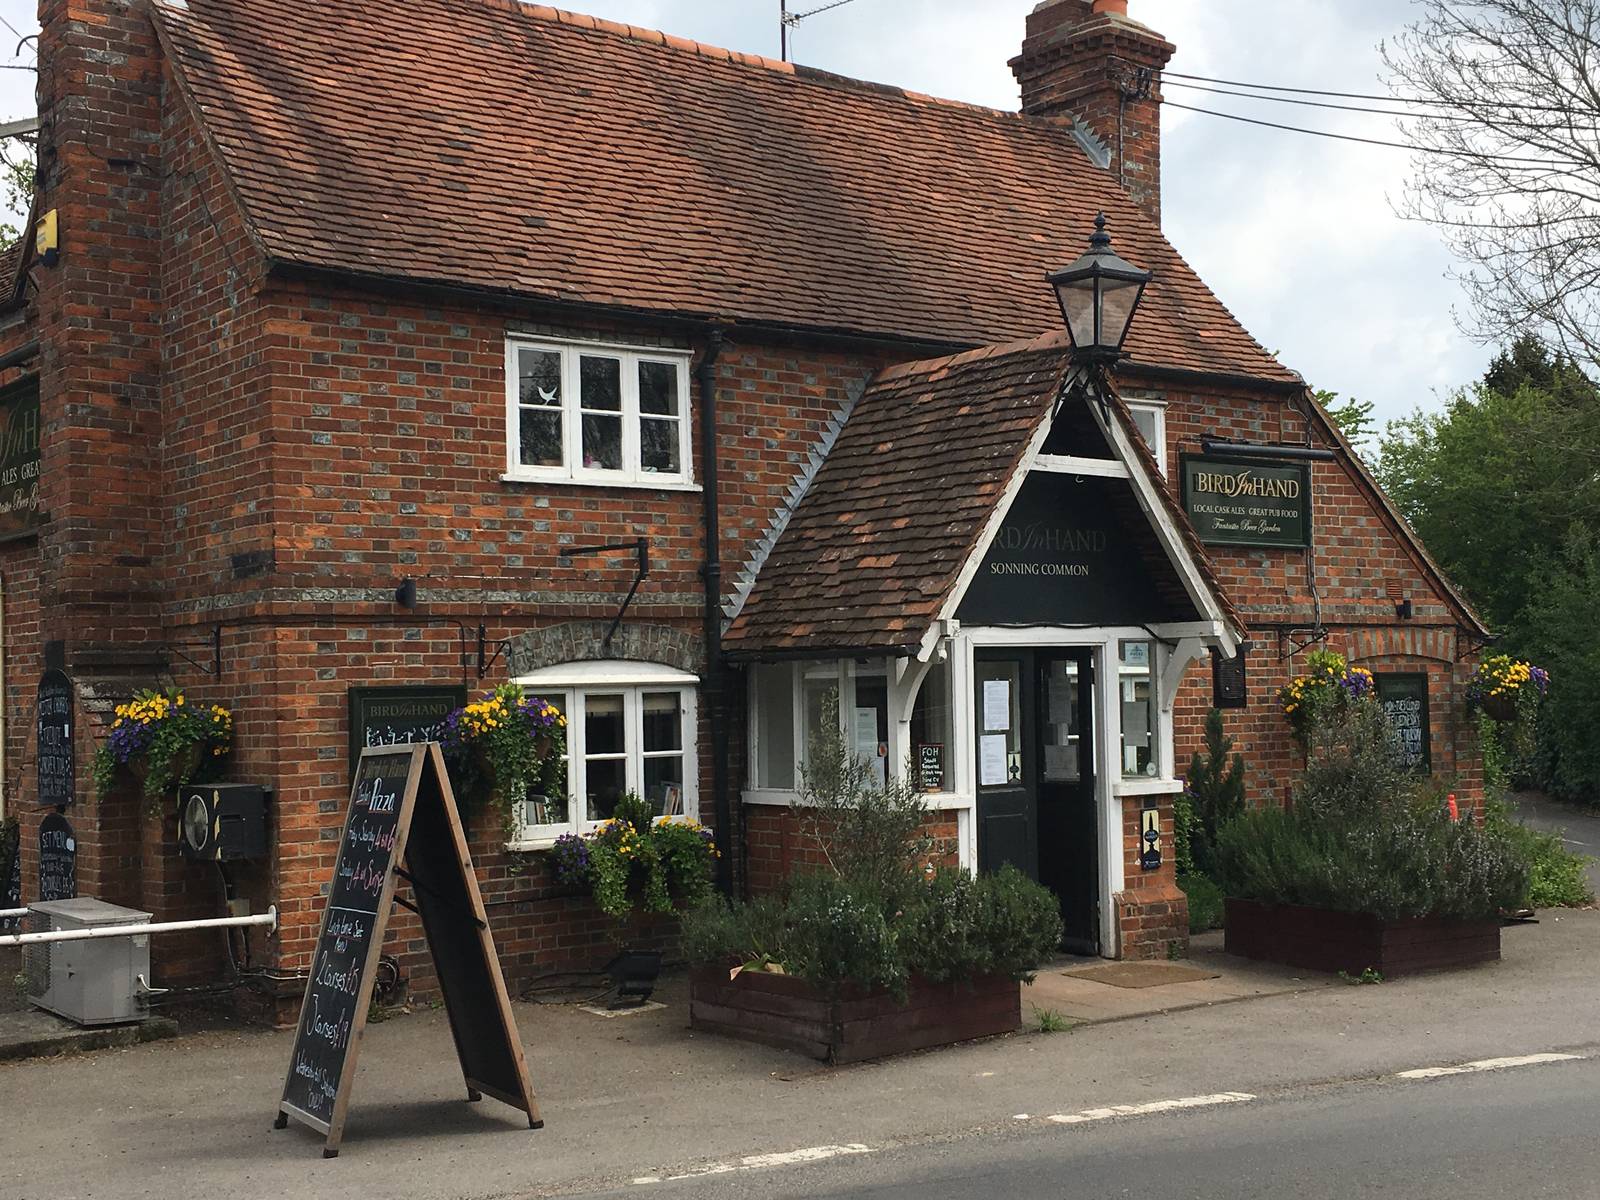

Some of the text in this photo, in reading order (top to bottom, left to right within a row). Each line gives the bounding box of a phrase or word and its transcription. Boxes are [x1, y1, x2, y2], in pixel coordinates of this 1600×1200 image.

[2, 467, 17, 486] ALES
[1197, 473, 1236, 494] BIRD
[1253, 477, 1299, 498] HAND
[1193, 504, 1298, 518] LOCAL CASK ALES GREAT PUB FOOD
[1240, 519, 1257, 531] Beer
[1257, 519, 1281, 534] Garden
[992, 527, 1021, 550] RD
[1045, 528, 1107, 552] HAND
[990, 562, 1089, 576] SONNING COMMON
[370, 704, 399, 717] BIRD
[411, 703, 448, 716] HAND
[922, 747, 939, 757] FOH
[316, 950, 328, 986] 2
[307, 993, 319, 1036] 3
